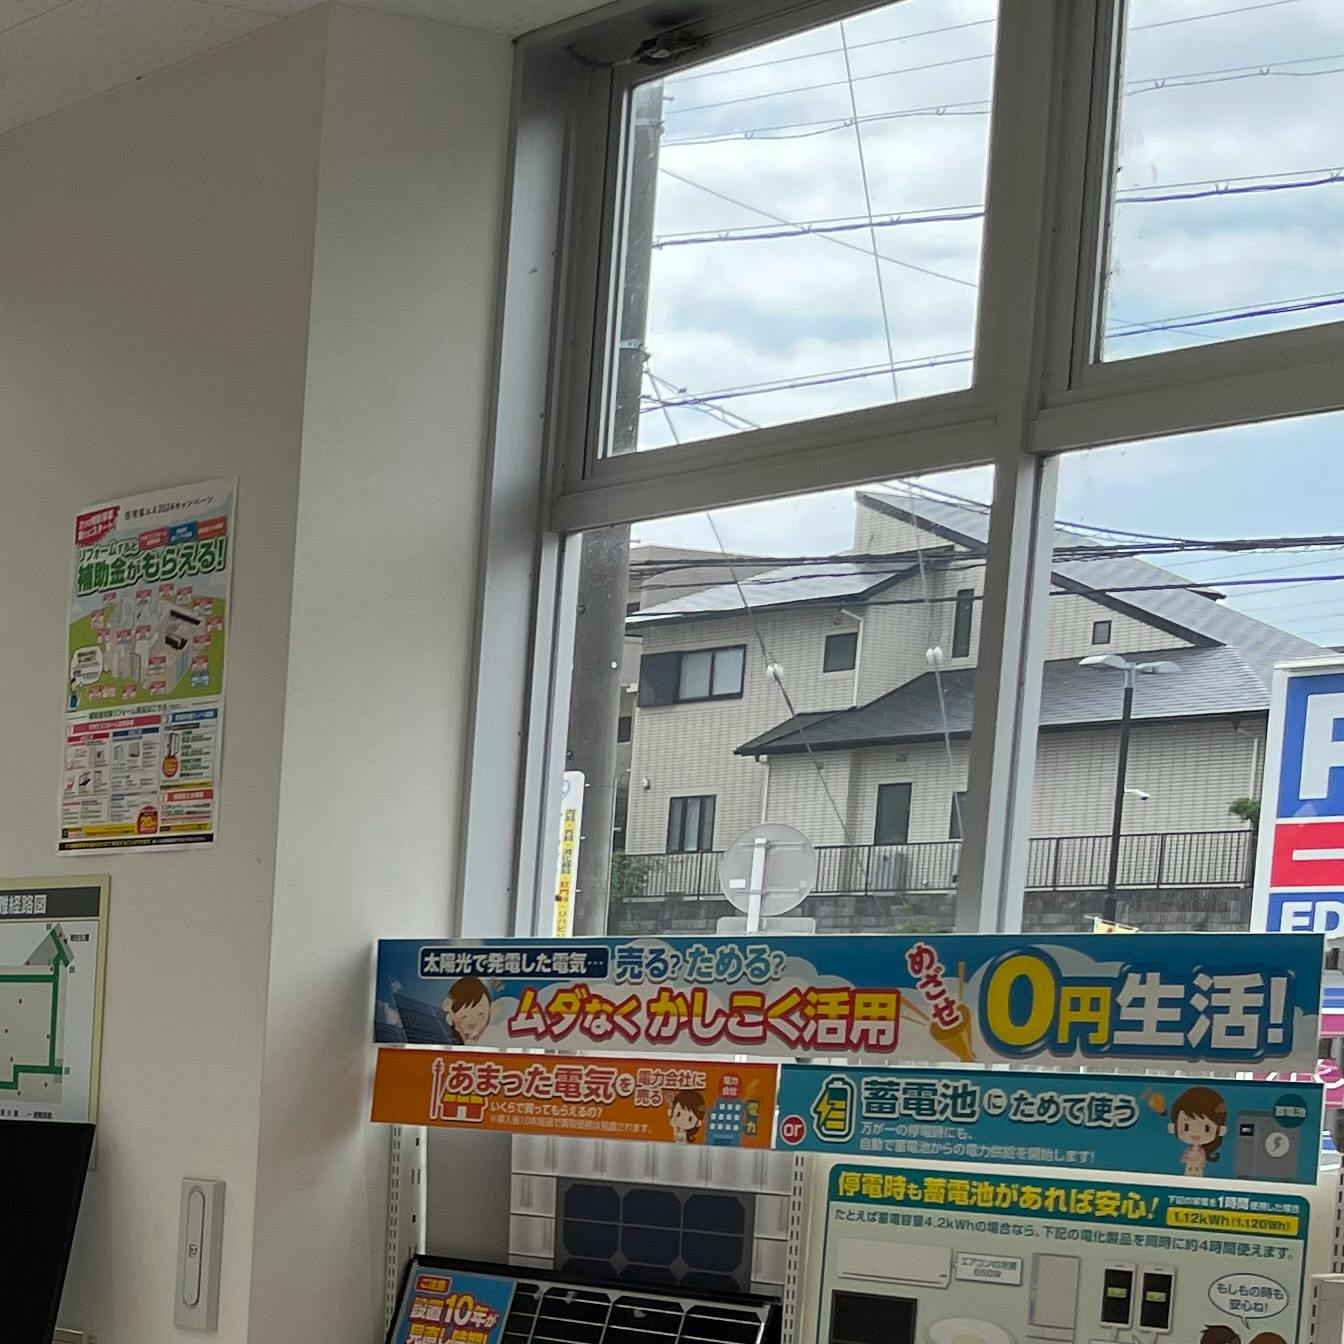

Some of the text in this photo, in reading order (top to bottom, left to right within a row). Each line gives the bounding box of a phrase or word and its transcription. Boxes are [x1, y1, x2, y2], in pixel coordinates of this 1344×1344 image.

[77, 537, 227, 593] 補助金がもらえる!
[906, 943, 961, 1026] めざせ
[987, 953, 1288, 1050] 0円生活!
[637, 1068, 706, 1090] 電力会社に
[490, 1101, 603, 1119] いくらで買ってもらえるの?
[860, 1078, 1140, 1128] 蓄電池にためて使う
[783, 1123, 804, 1138] or
[860, 1122, 974, 1140] 万が一の停電時にも、
[859, 1137, 1096, 1165] 自動で蓄電池からの電力供給を開始します!
[837, 1170, 1159, 1220] 停電時も蓄電池があれば安心!
[1216, 1282, 1285, 1301] もしもの時も
